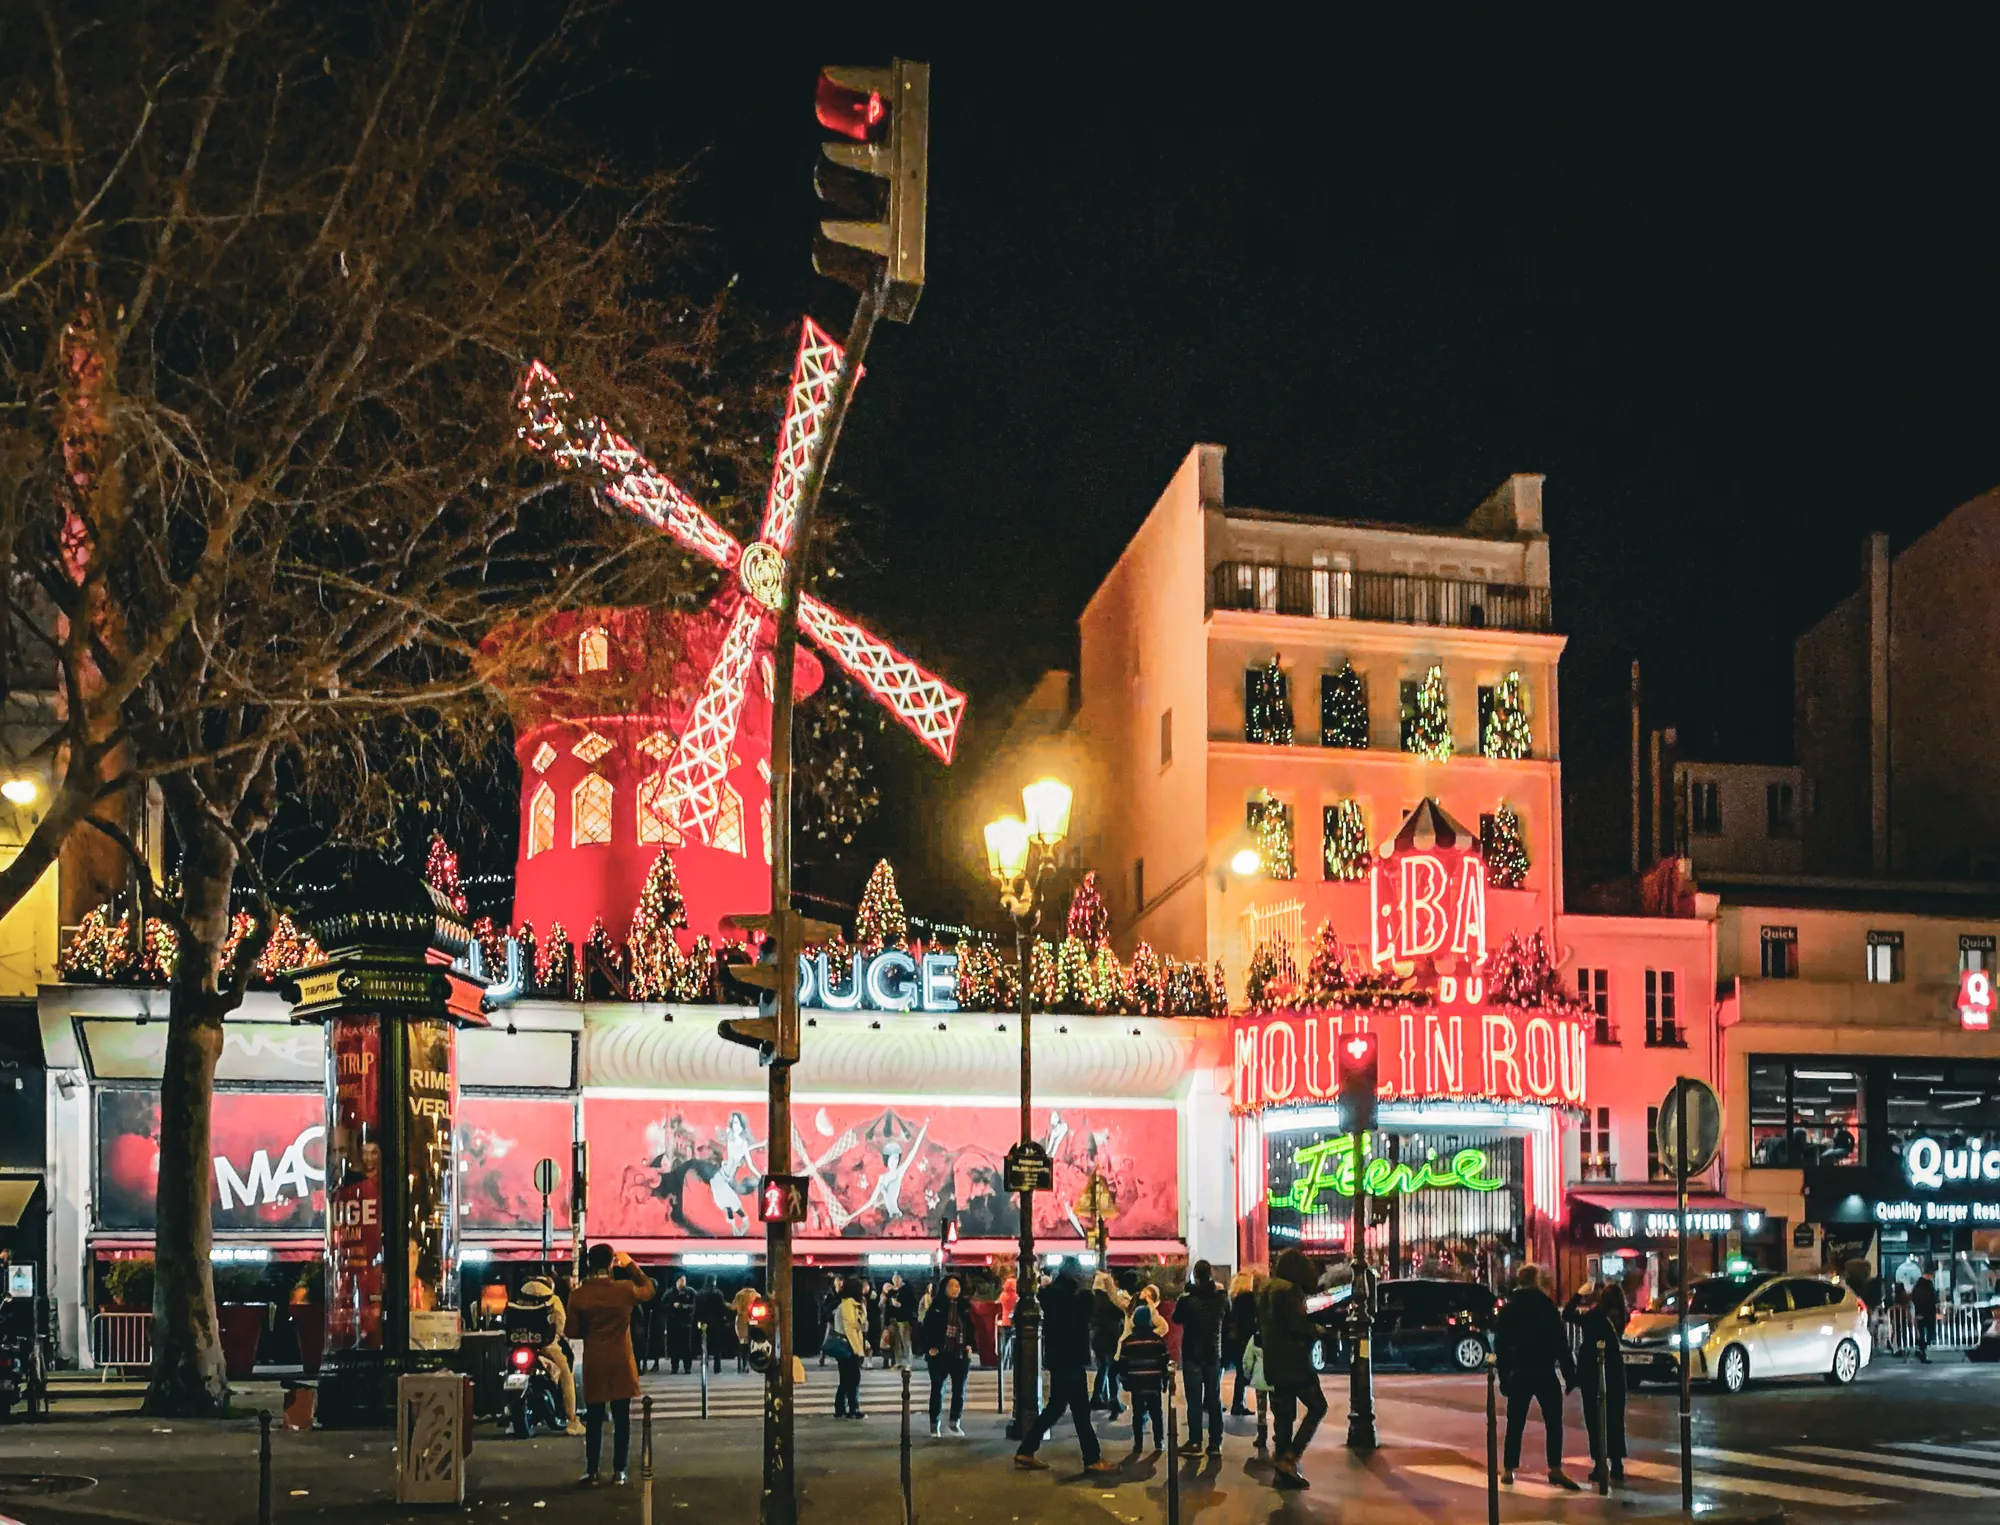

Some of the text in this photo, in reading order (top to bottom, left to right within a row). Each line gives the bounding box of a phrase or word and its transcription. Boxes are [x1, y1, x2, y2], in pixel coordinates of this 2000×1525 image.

[1761, 928, 1796, 941] Quick
[1961, 936, 1993, 949] Quick
[1440, 976, 1483, 1004] DU
[1967, 973, 1990, 1007] Q
[1876, 1202, 1921, 1223] Quality
[1927, 1202, 1968, 1223] Burger
[511, 1332, 542, 1343] eats
